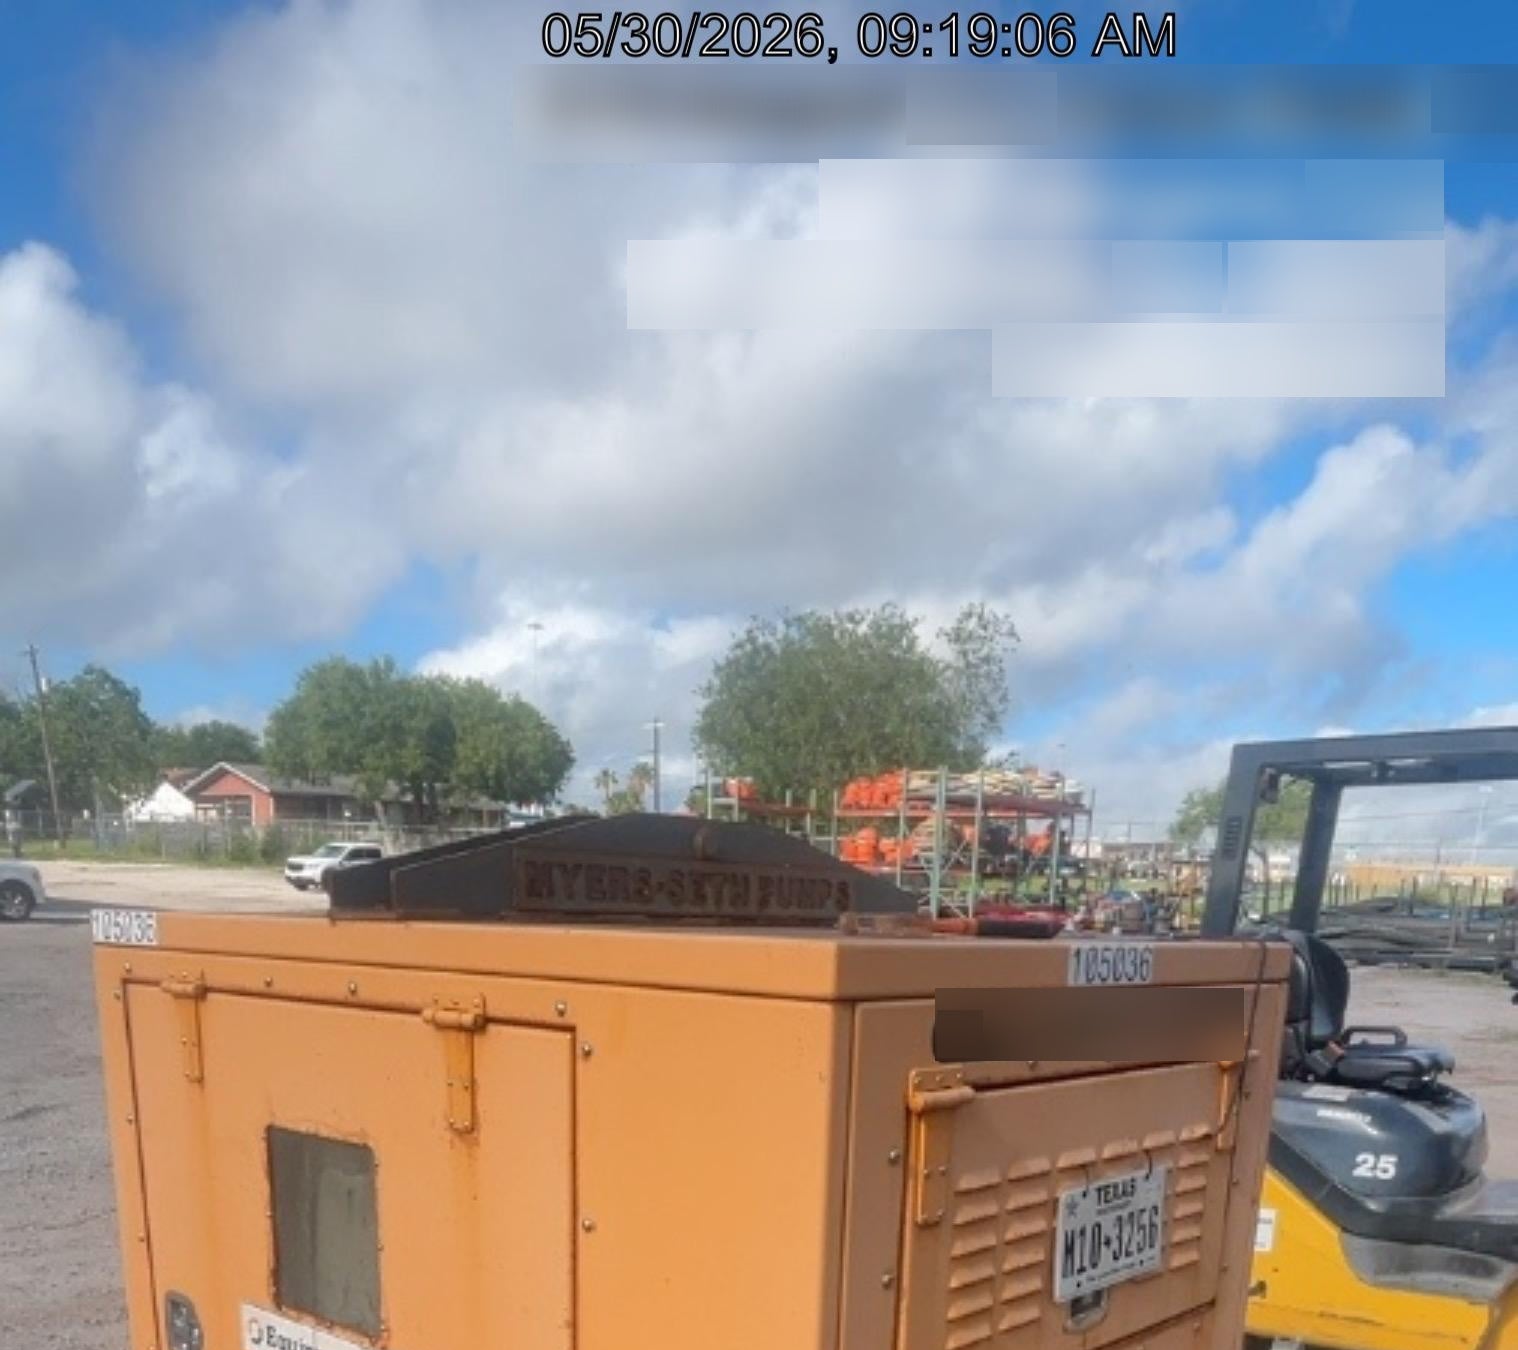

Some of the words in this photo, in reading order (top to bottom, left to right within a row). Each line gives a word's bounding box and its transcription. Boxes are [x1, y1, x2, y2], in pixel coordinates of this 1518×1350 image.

[757, 874, 851, 912] PUMPS
[95, 910, 154, 943] 105036
[1073, 945, 1153, 984] 105036
[1352, 1151, 1399, 1181] 25
[1095, 1177, 1136, 1206] TEXAS
